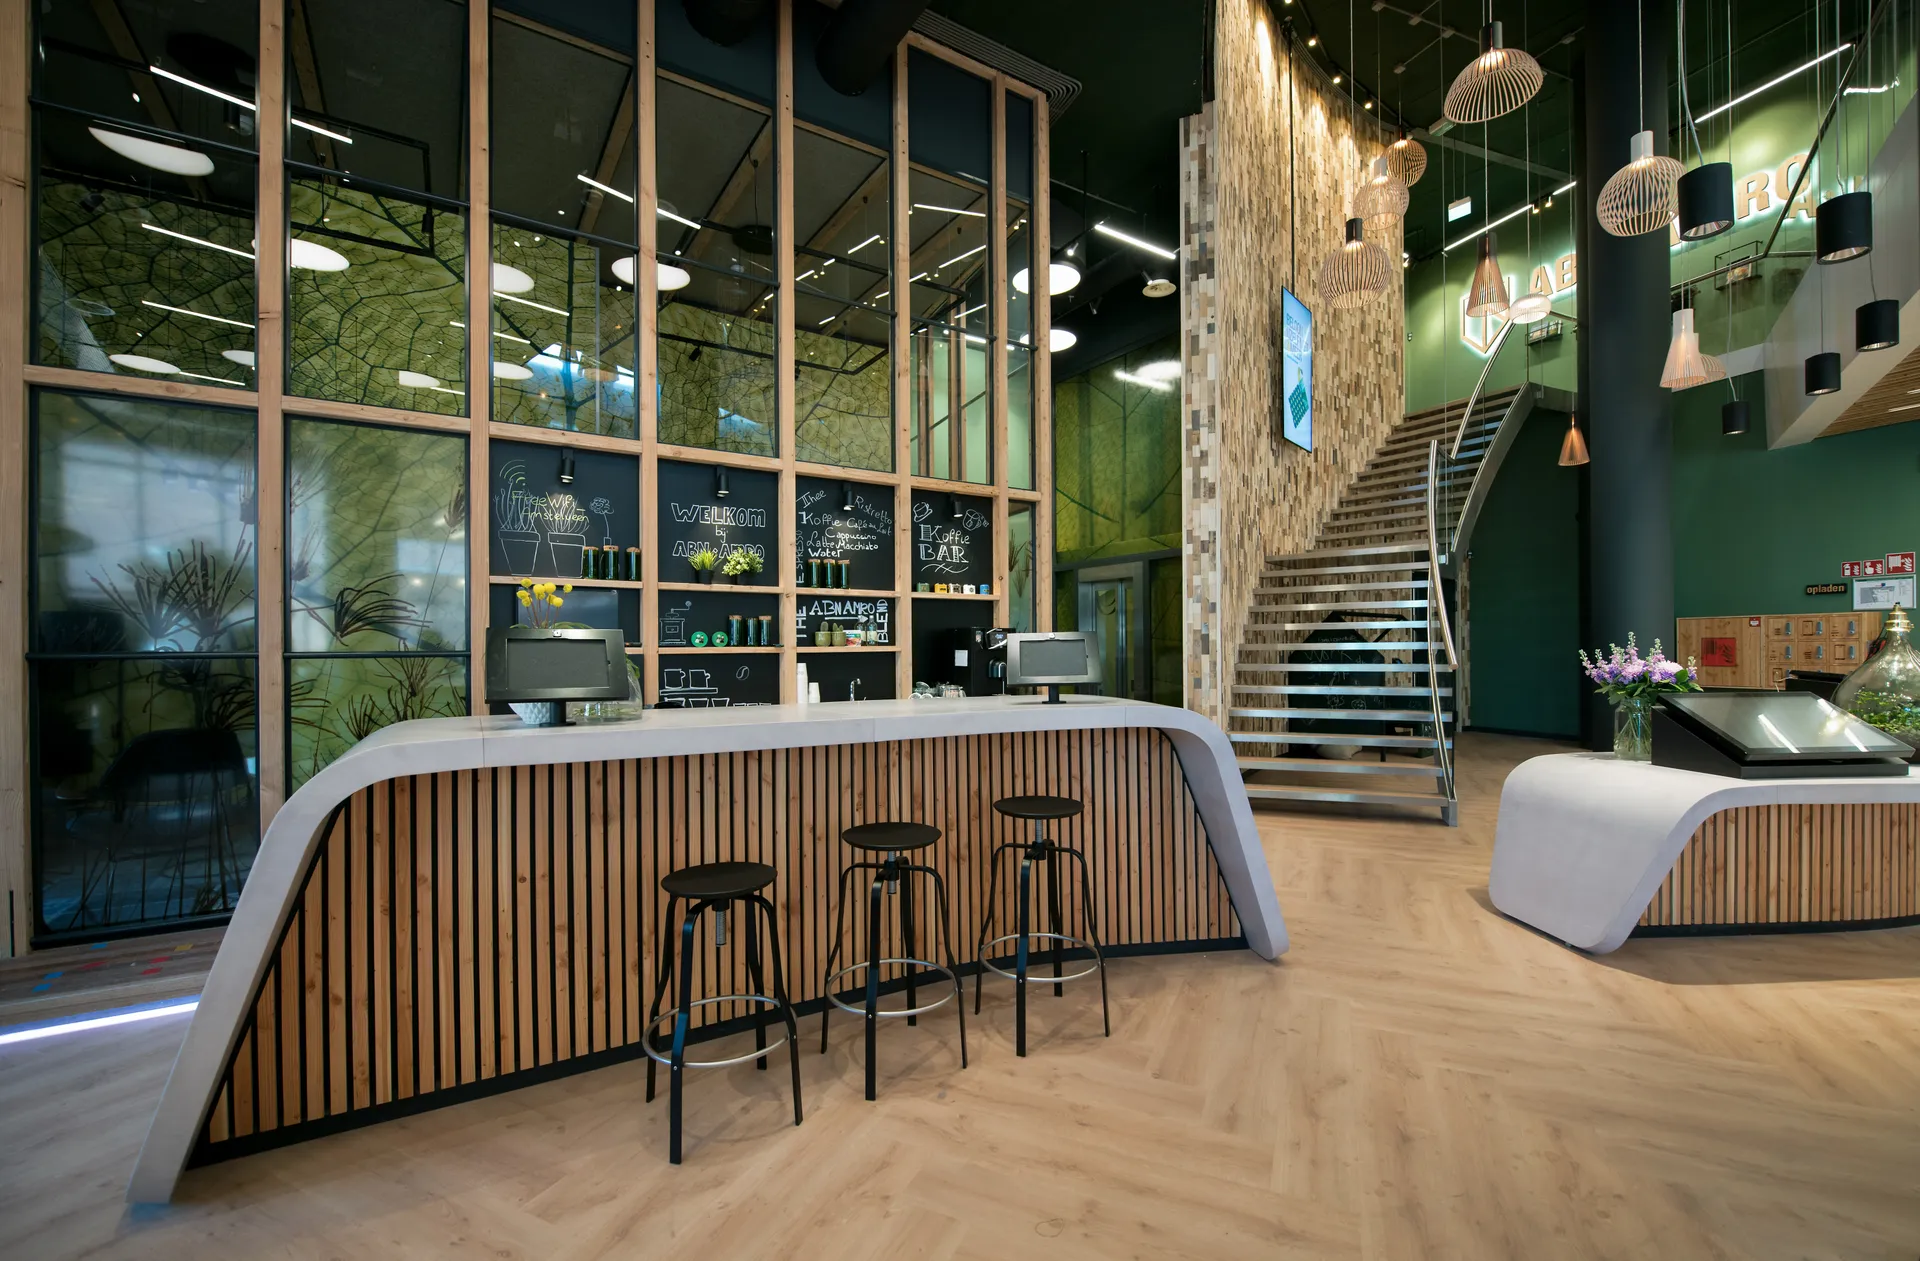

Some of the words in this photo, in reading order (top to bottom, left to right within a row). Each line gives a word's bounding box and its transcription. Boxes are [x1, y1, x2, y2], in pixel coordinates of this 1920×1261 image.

[1529, 253, 1577, 297] AB
[796, 490, 826, 509] Thee
[854, 495, 892, 524] Ristretto
[671, 502, 766, 527] WELKOM
[798, 511, 842, 527] Koffie
[806, 530, 835, 548] Latte
[835, 539, 879, 550] Macchiato
[825, 527, 876, 541] Cappuccino
[919, 524, 970, 544] Koffie
[808, 548, 843, 558] Water
[918, 543, 969, 563] BAR
[1807, 584, 1845, 595] opladen
[876, 599, 889, 643] BLEND
